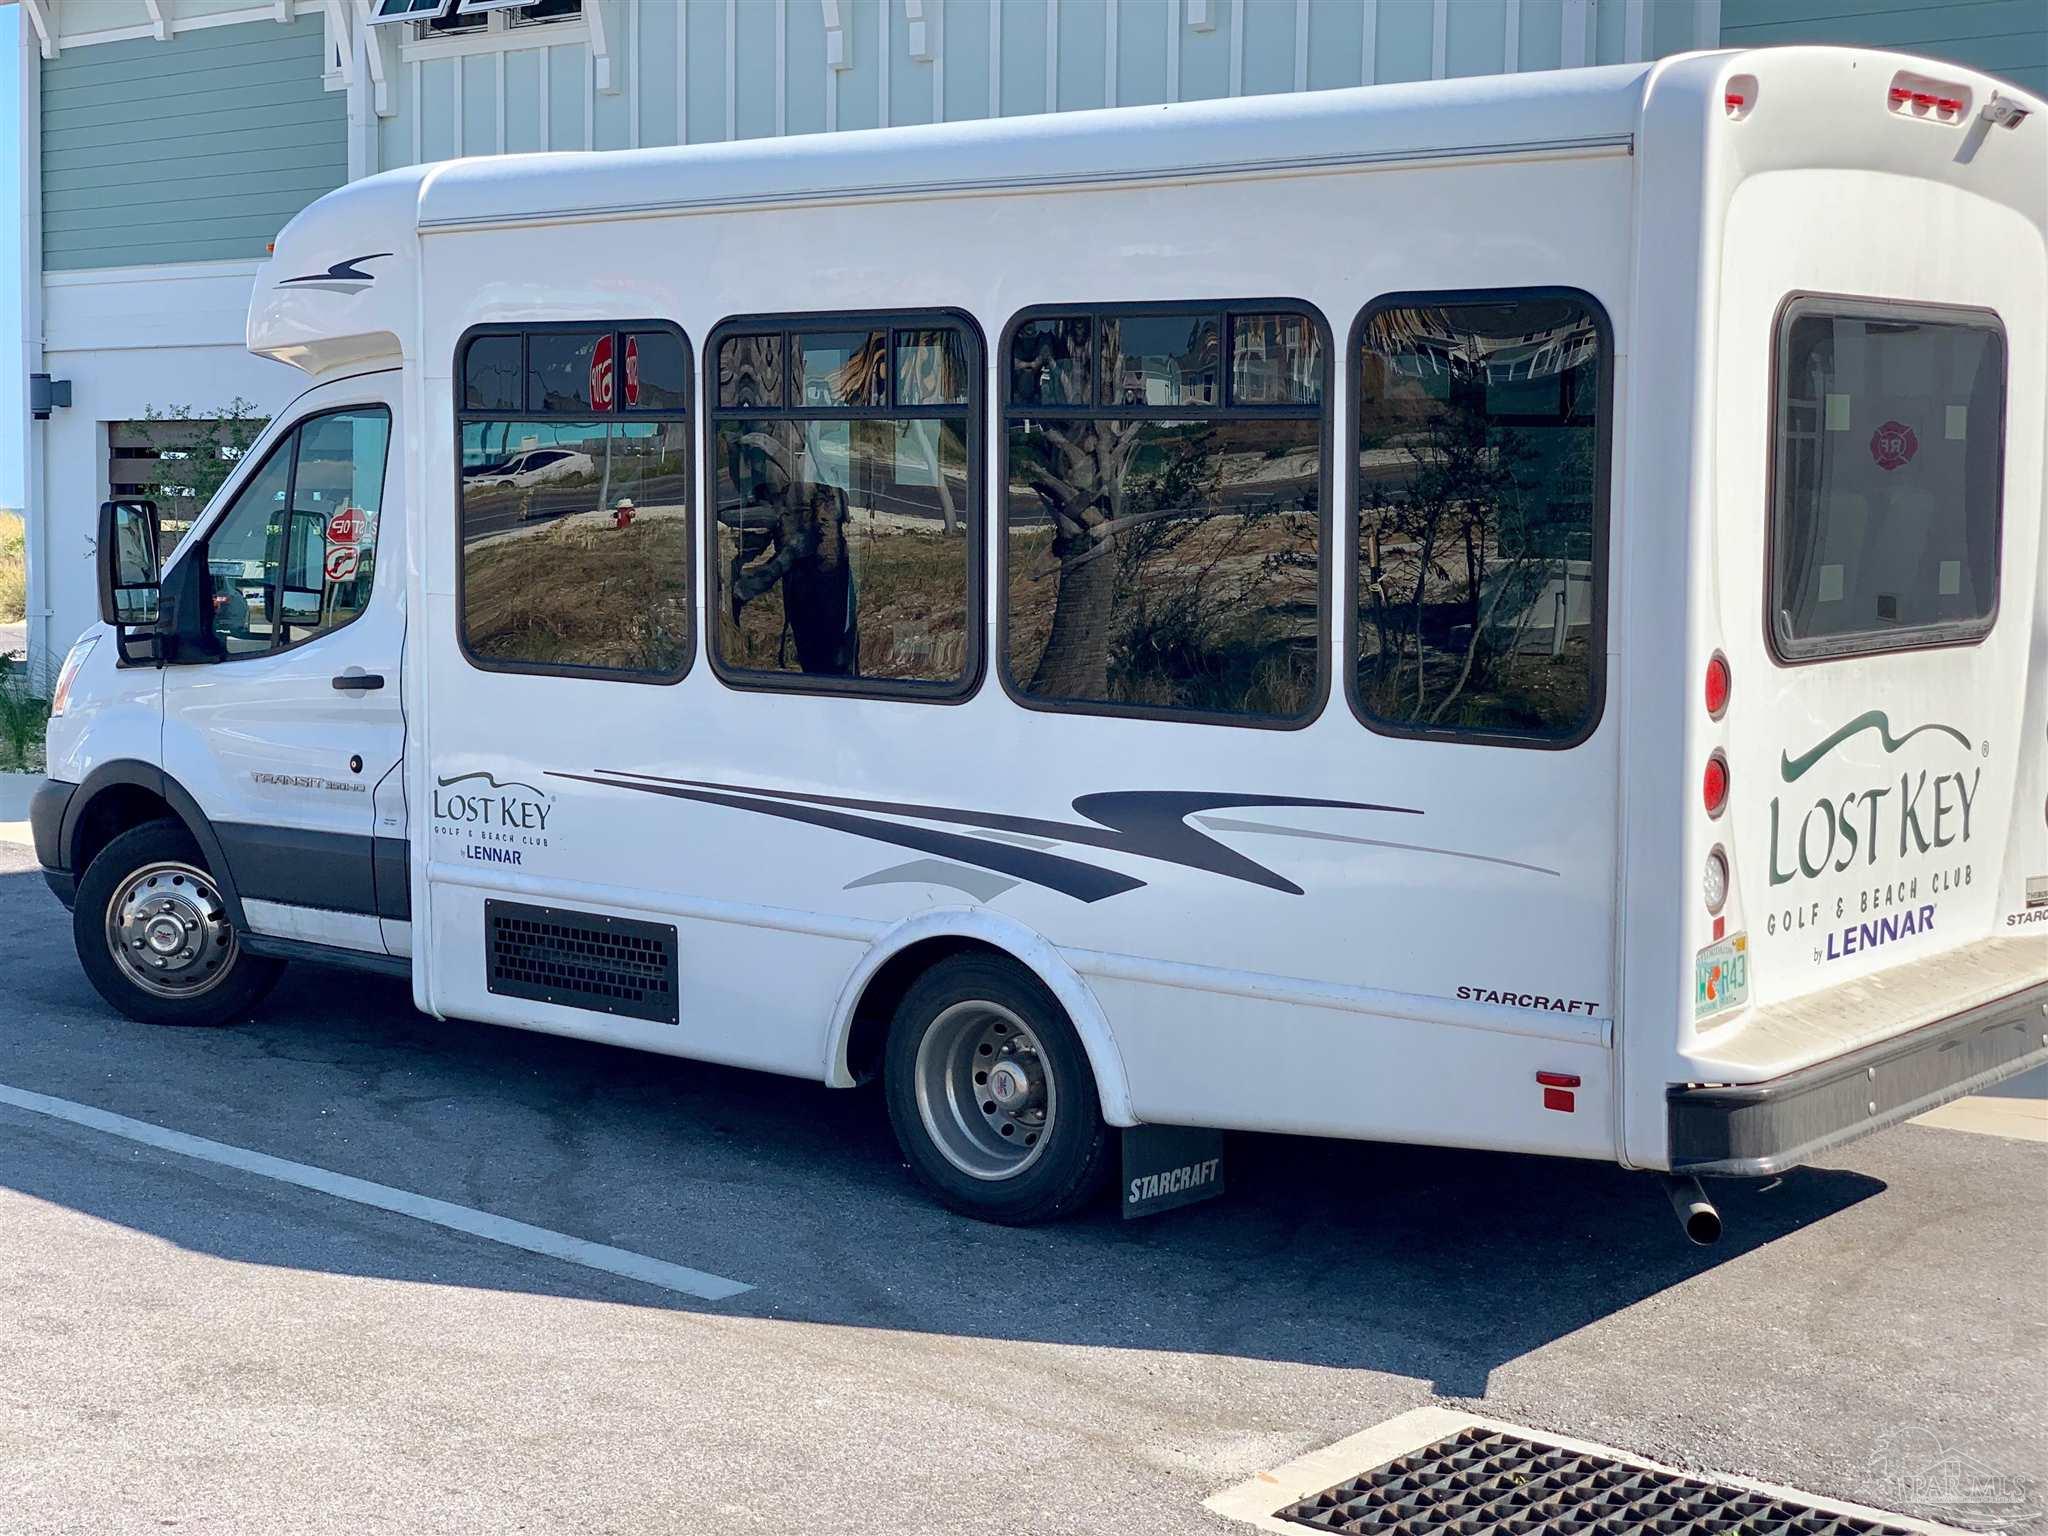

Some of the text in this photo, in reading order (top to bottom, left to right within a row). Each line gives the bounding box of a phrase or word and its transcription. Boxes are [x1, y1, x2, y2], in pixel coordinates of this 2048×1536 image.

[251, 771, 322, 788] TRANSIT
[434, 789, 551, 830] LOST KEY
[1769, 767, 1981, 887] LOST KEY
[434, 826, 460, 836] GOLF
[481, 831, 514, 842] BEACH
[522, 836, 548, 847] CLUB
[467, 844, 521, 865] LENNAR
[1767, 864, 1971, 936] GOLF & BEACH CLUB
[1813, 904, 1935, 965] by LENNAR
[1456, 986, 1599, 1016] STARCRAFT
[1128, 1158, 1219, 1203] STARCRAFT
